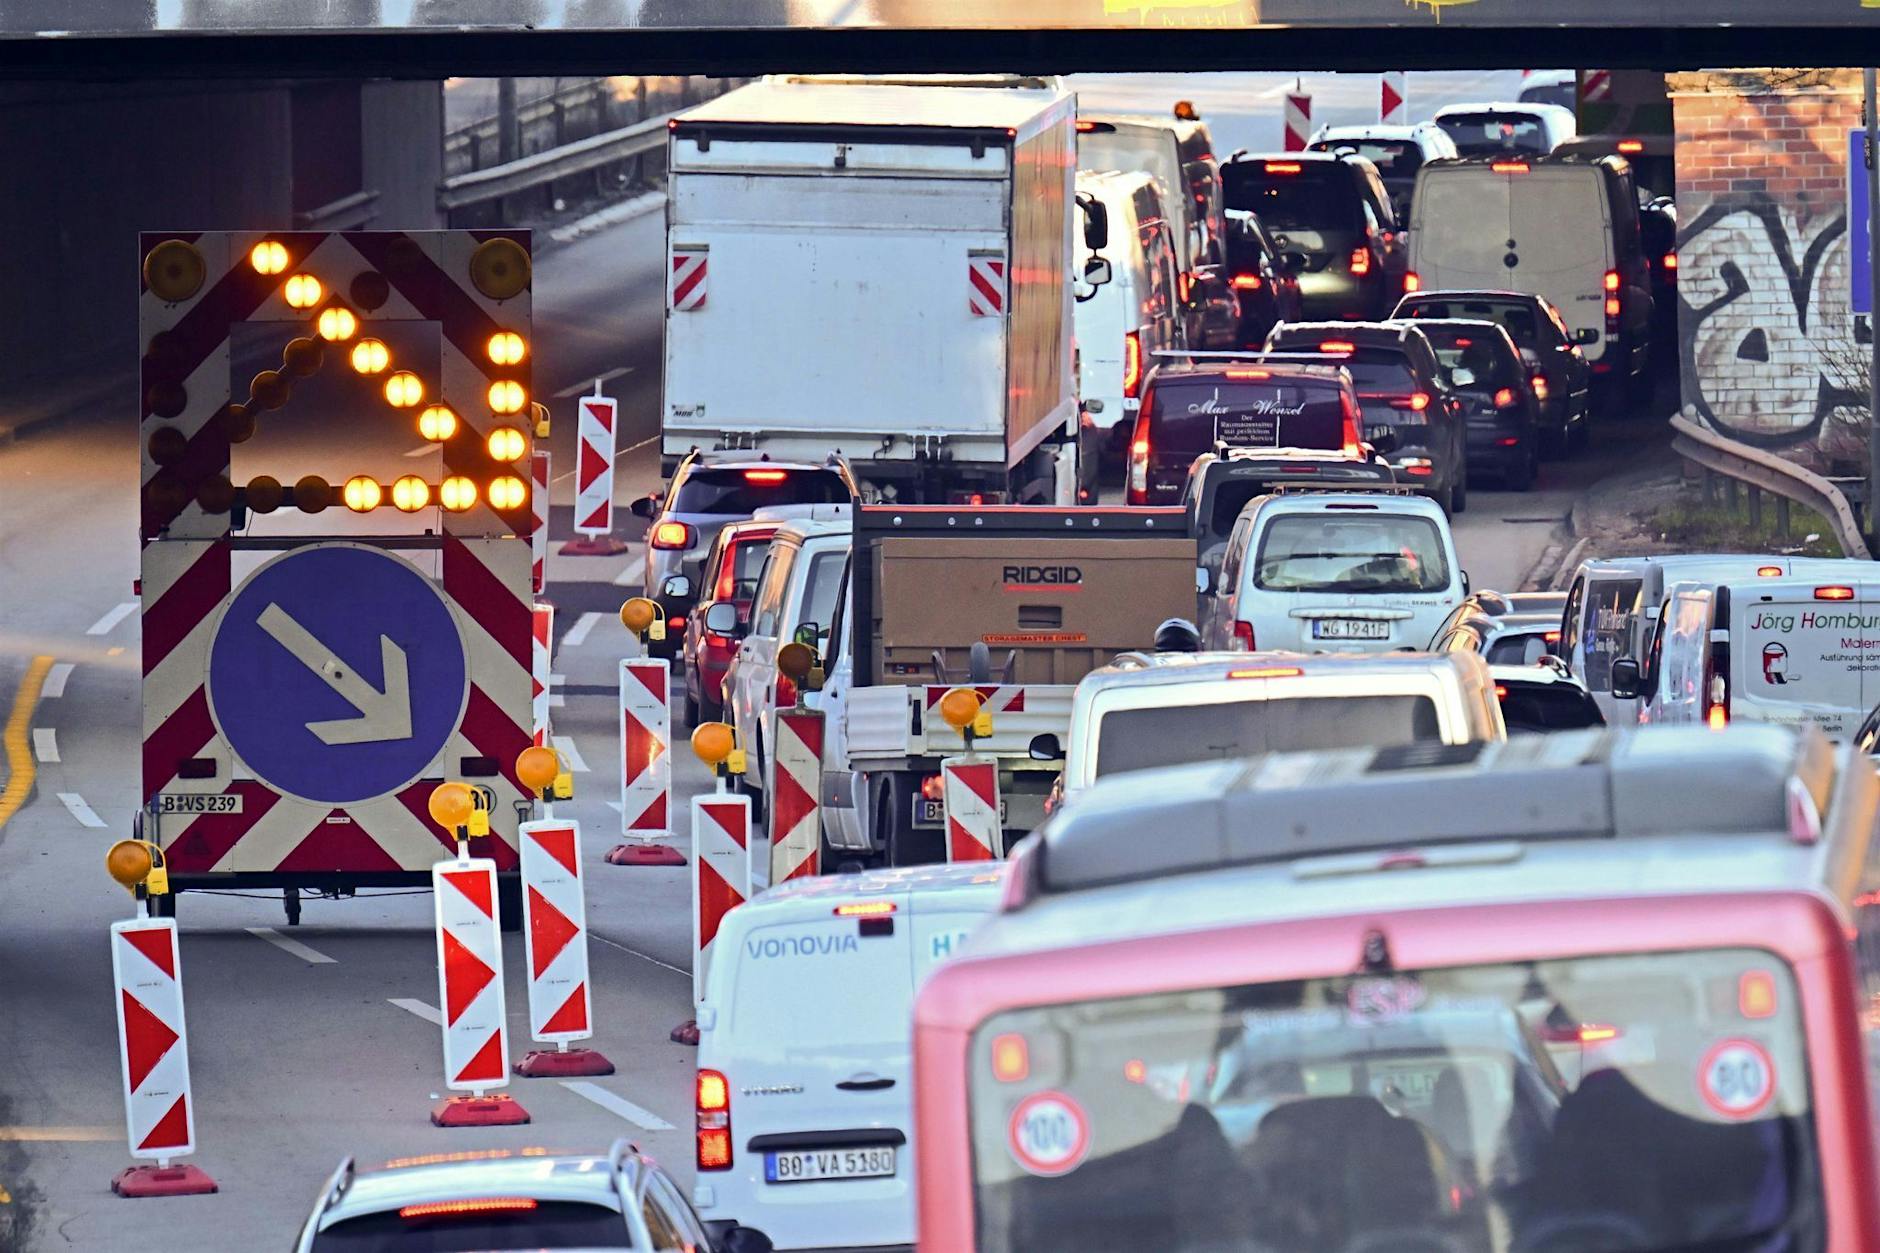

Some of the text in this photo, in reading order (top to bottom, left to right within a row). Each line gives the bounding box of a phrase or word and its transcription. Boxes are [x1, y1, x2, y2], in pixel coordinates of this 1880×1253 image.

[1187, 399, 1306, 416] Max Wenzel
[1002, 565, 1083, 584] RIDGID
[1321, 620, 1388, 637] WG 1941F
[1750, 612, 1880, 633] Jörg Hombur
[1822, 724, 1843, 733] Berlin
[207, 796, 237, 812] 239
[778, 1150, 892, 1178] BO VA 5180
